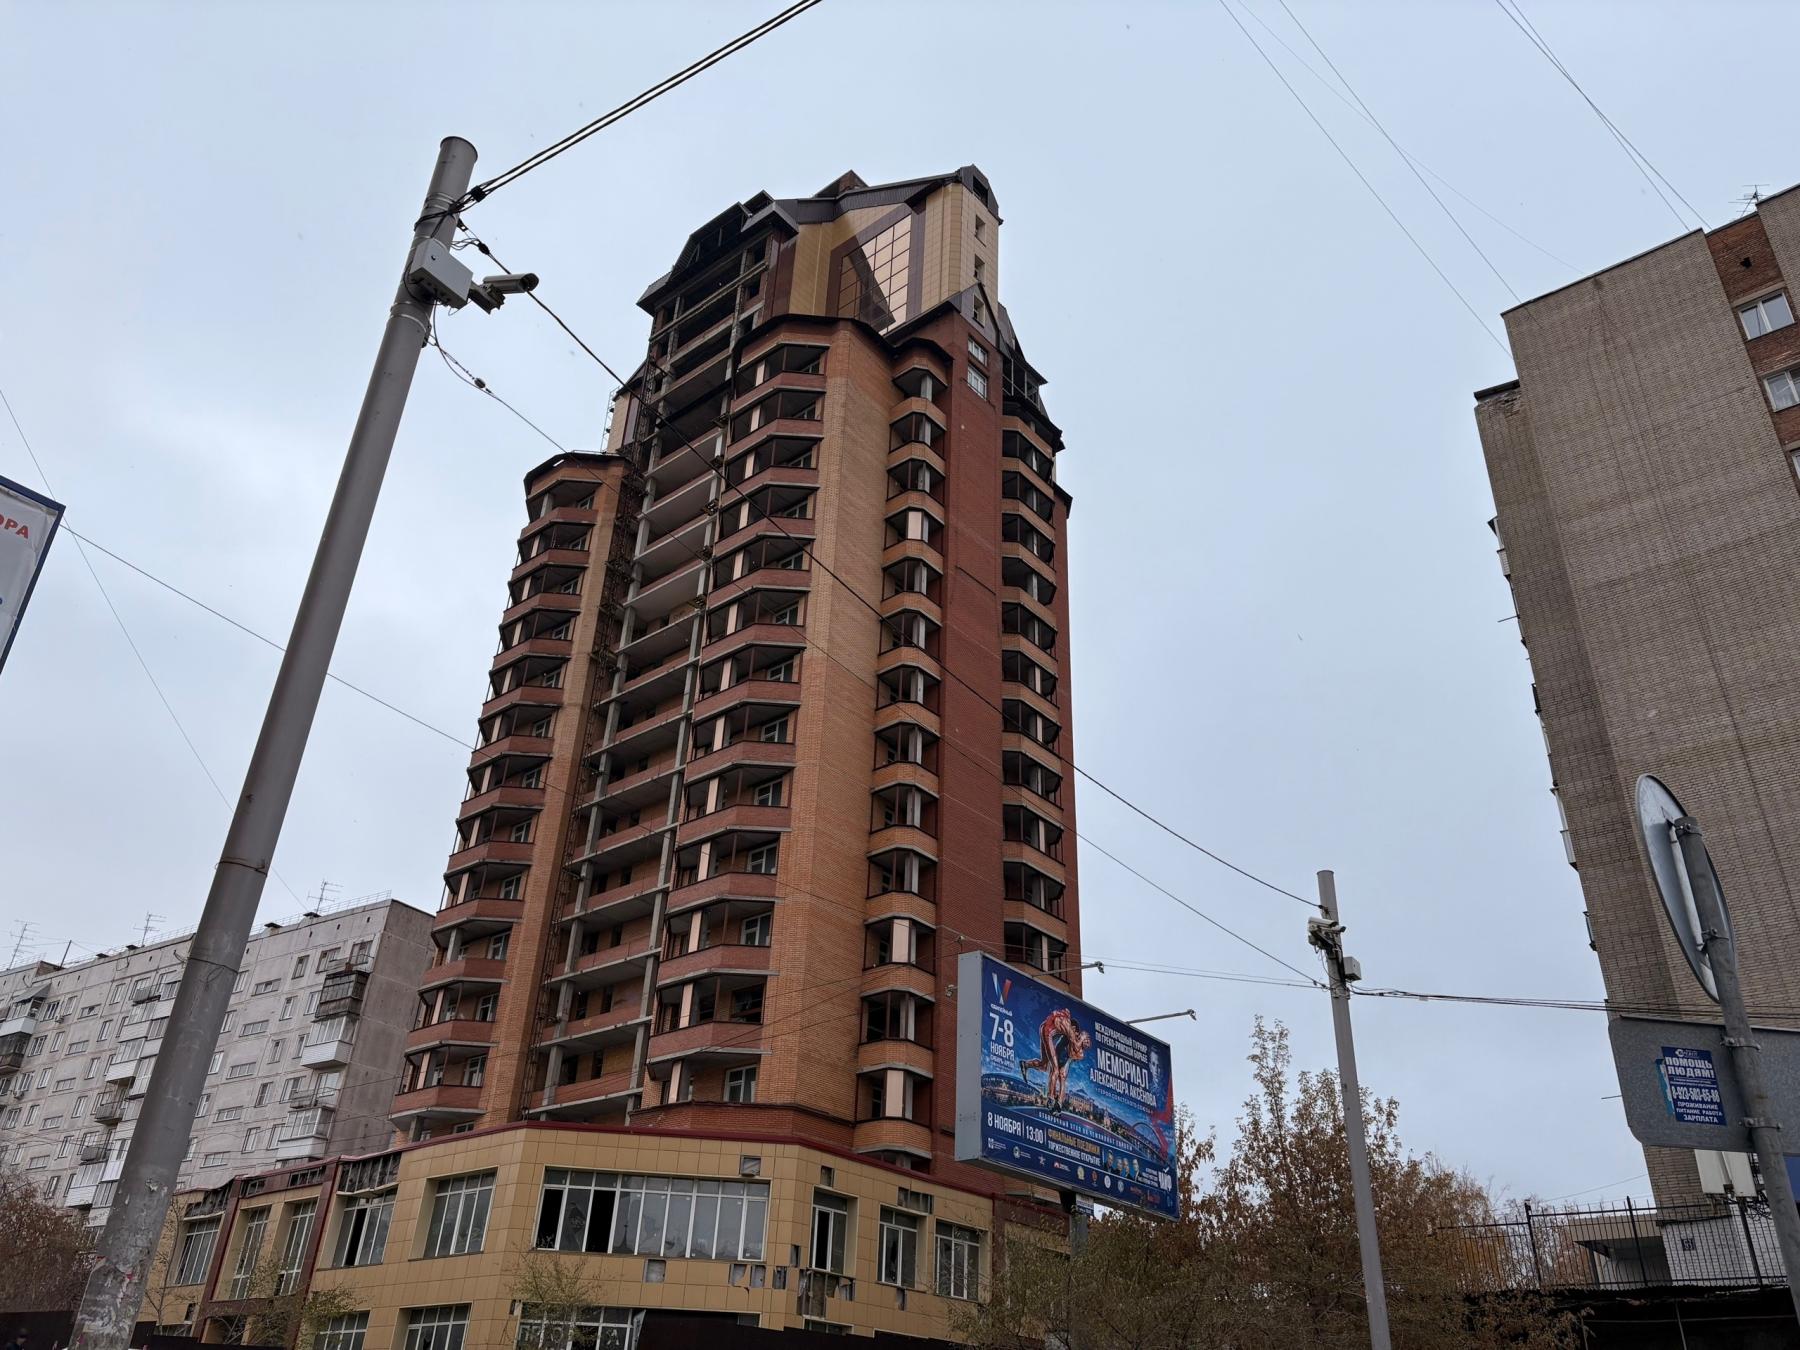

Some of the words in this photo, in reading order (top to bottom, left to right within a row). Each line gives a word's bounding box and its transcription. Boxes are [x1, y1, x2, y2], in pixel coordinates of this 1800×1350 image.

[0, 516, 29, 539] РА
[989, 1012, 1014, 1047] 7-8
[1095, 1021, 1132, 1046] МЕЖДУНАРОДНЫЙ
[1132, 1039, 1148, 1052] ТУРНИР
[990, 1041, 1015, 1061] НОЯБРЯ
[1101, 1034, 1133, 1057] ГРЕКО-РИМСКОЙ
[1133, 1049, 1148, 1063] БОРЬБЕ
[1097, 1047, 1149, 1090] МЕМОРИАЛ
[1665, 1056, 1713, 1069] ПОМОЩЬ
[1667, 1066, 1715, 1078] ЛЮДЯМ!
[1090, 1067, 1129, 1096] АЛЕКСАНДРА
[1677, 1101, 1719, 1110] ПРОЖИВАНИЕ
[1683, 1114, 1719, 1123] ЗАРПЛАТА
[987, 1112, 993, 1127] 8
[994, 1114, 1022, 1137] НОЯБРЯ
[1025, 1125, 1044, 1144] 13:00
[1048, 1140, 1080, 1159] ТОРЖЕСТВЕННОЕ
[1080, 1152, 1100, 1166] ОТКРЫТИЕ
